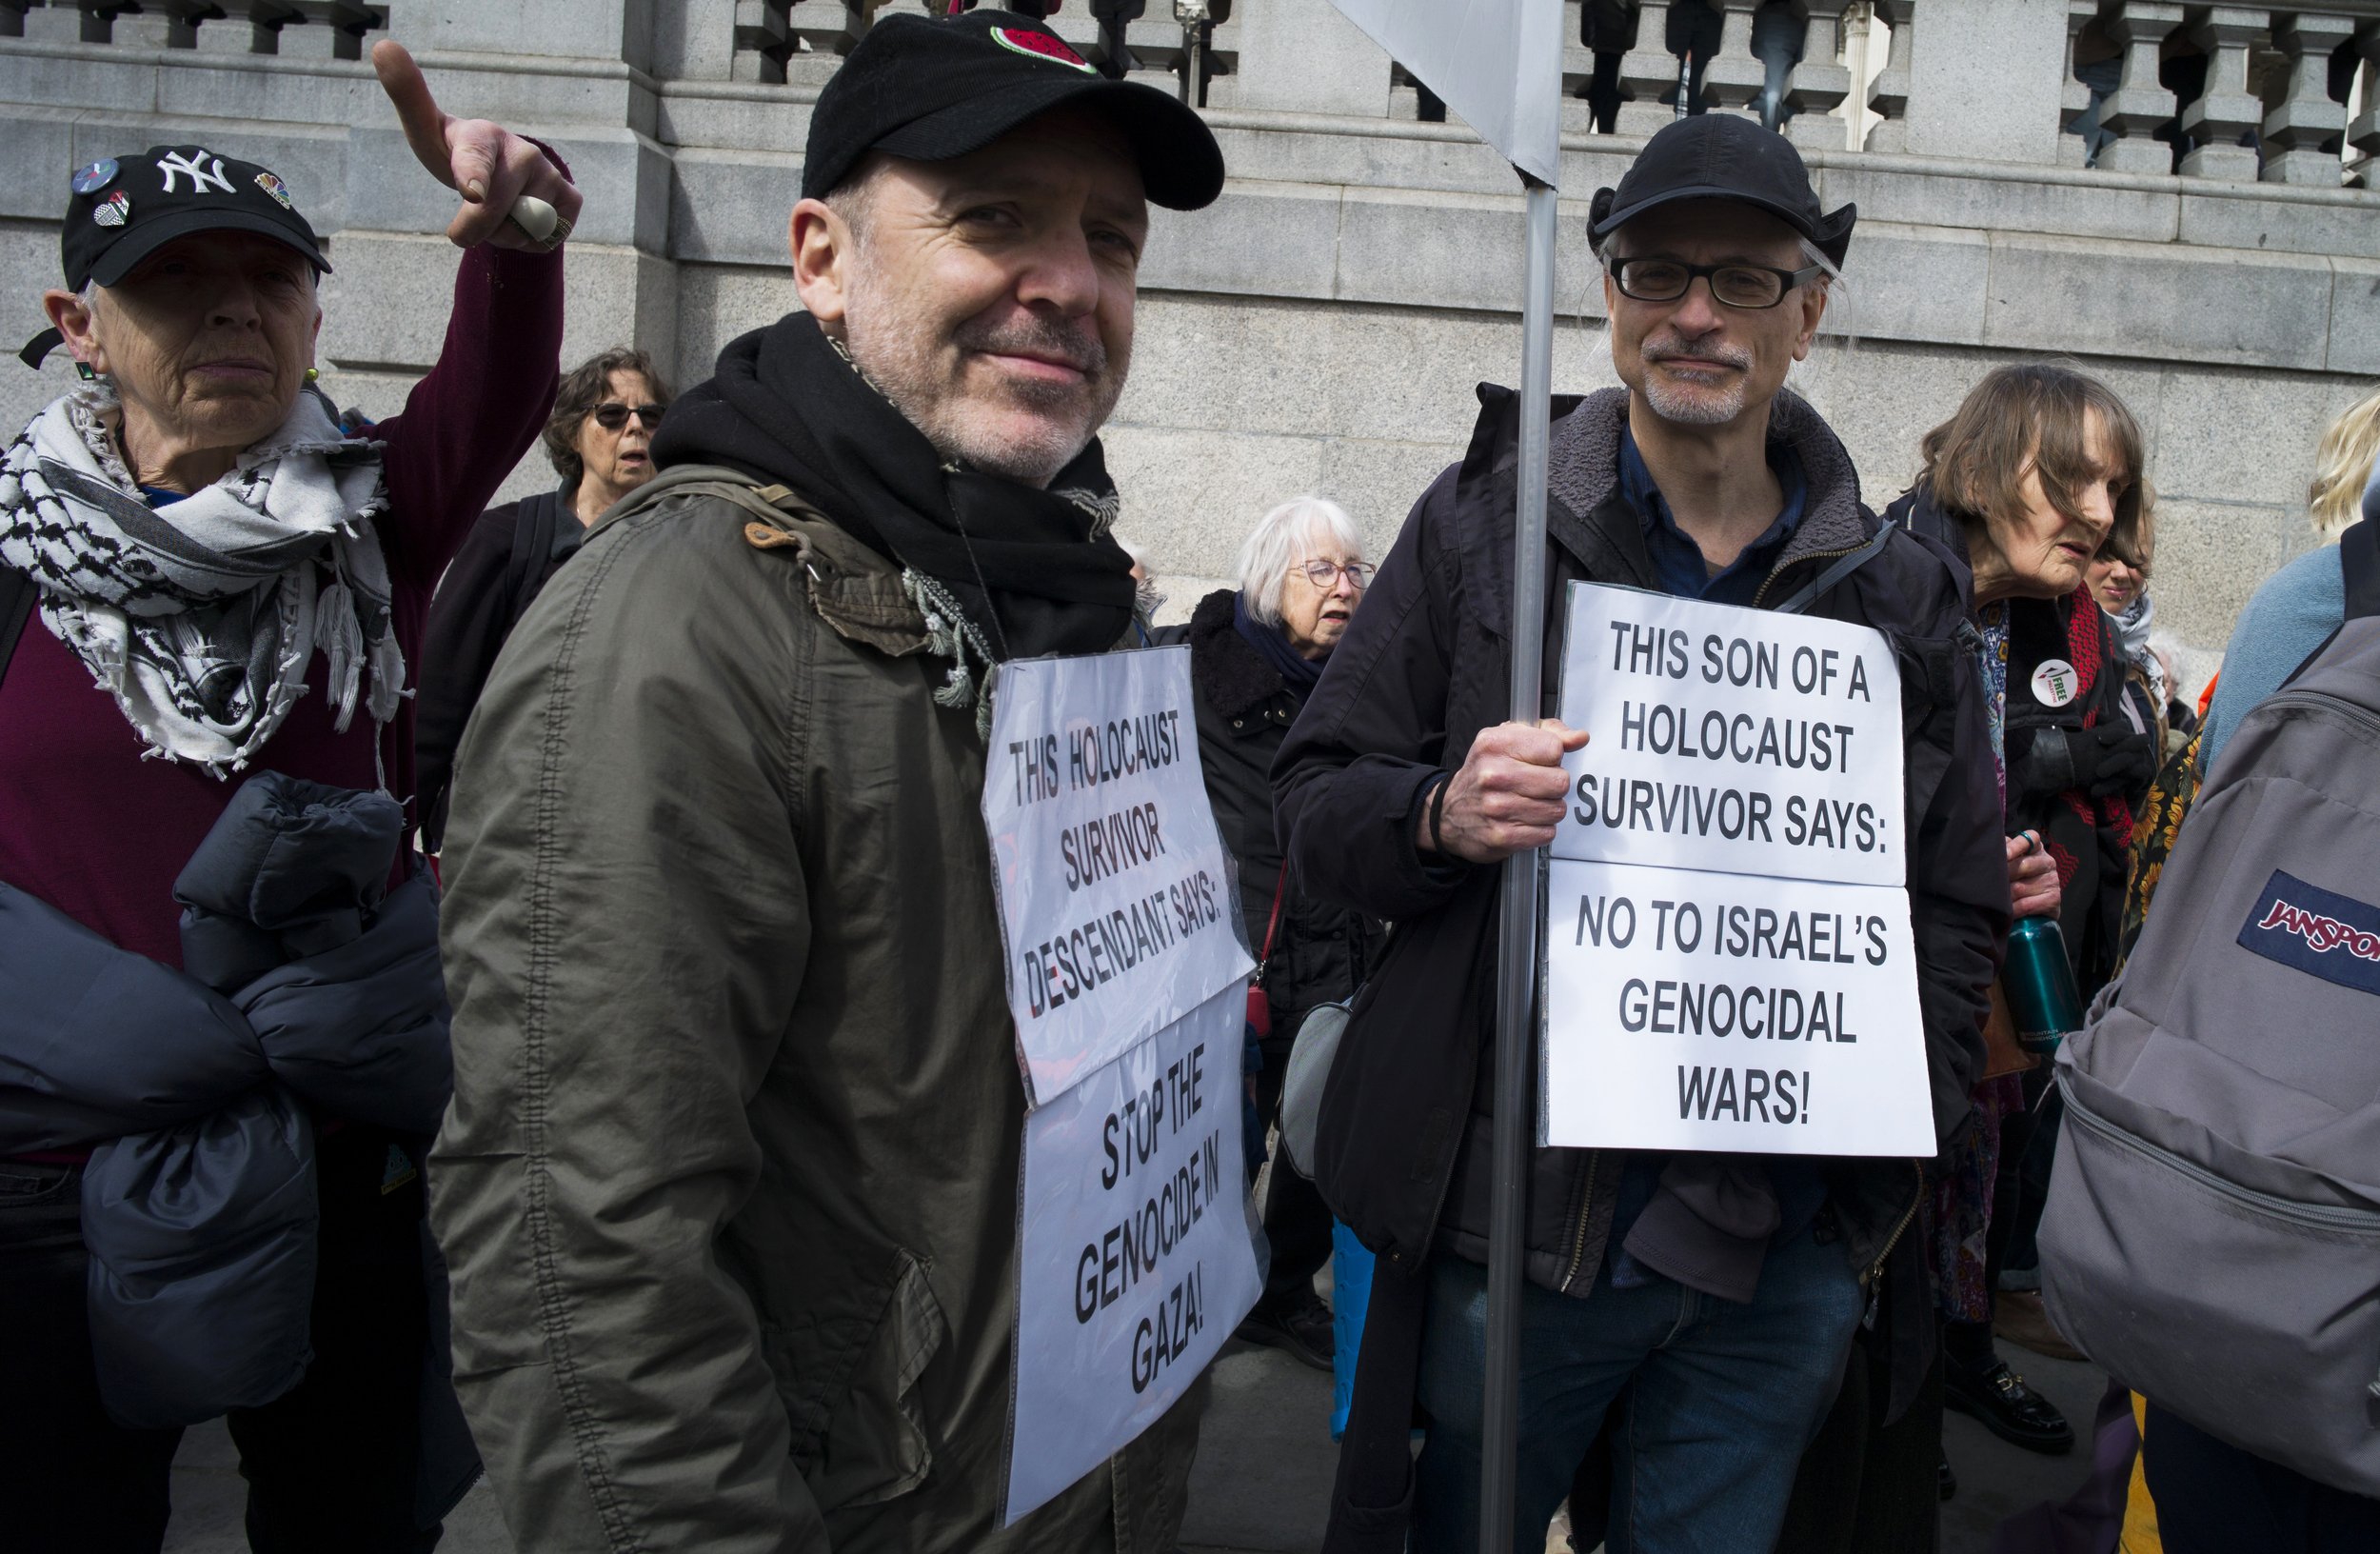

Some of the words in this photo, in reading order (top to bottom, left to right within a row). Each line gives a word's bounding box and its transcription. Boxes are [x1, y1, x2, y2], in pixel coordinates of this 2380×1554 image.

[156, 150, 237, 193] NY
[1611, 620, 1689, 679] THIS
[1701, 634, 1778, 690] SON
[1793, 646, 1839, 696] OF
[1847, 655, 1871, 703] A
[2048, 679, 2057, 703] PALESTINE
[2053, 677, 2068, 702] FREE
[1009, 733, 1059, 807] THIS
[1070, 709, 1180, 791] HOLOCAUST
[1620, 701, 1854, 773] HOLOCAUST
[1061, 802, 1166, 892] SURVIVOR
[1574, 773, 1773, 843] SURVIVOR
[1784, 795, 1887, 853] SAYS:
[1024, 890, 1175, 1020] DESCENDANT
[1169, 869, 1221, 940] SAYS:
[1576, 894, 1636, 949] NO
[1652, 900, 1702, 953] TO
[1715, 905, 1888, 966] ISRAEL'S
[1619, 978, 1857, 1044] GENOCIDAL
[1101, 1077, 1163, 1191] STOP
[1168, 1042, 1204, 1135] THE
[1677, 1065, 1810, 1126] WARS!
[1075, 1150, 1203, 1325] GENOCIDE
[1204, 1129, 1220, 1207] IN
[1132, 1260, 1204, 1394] GAZA!
